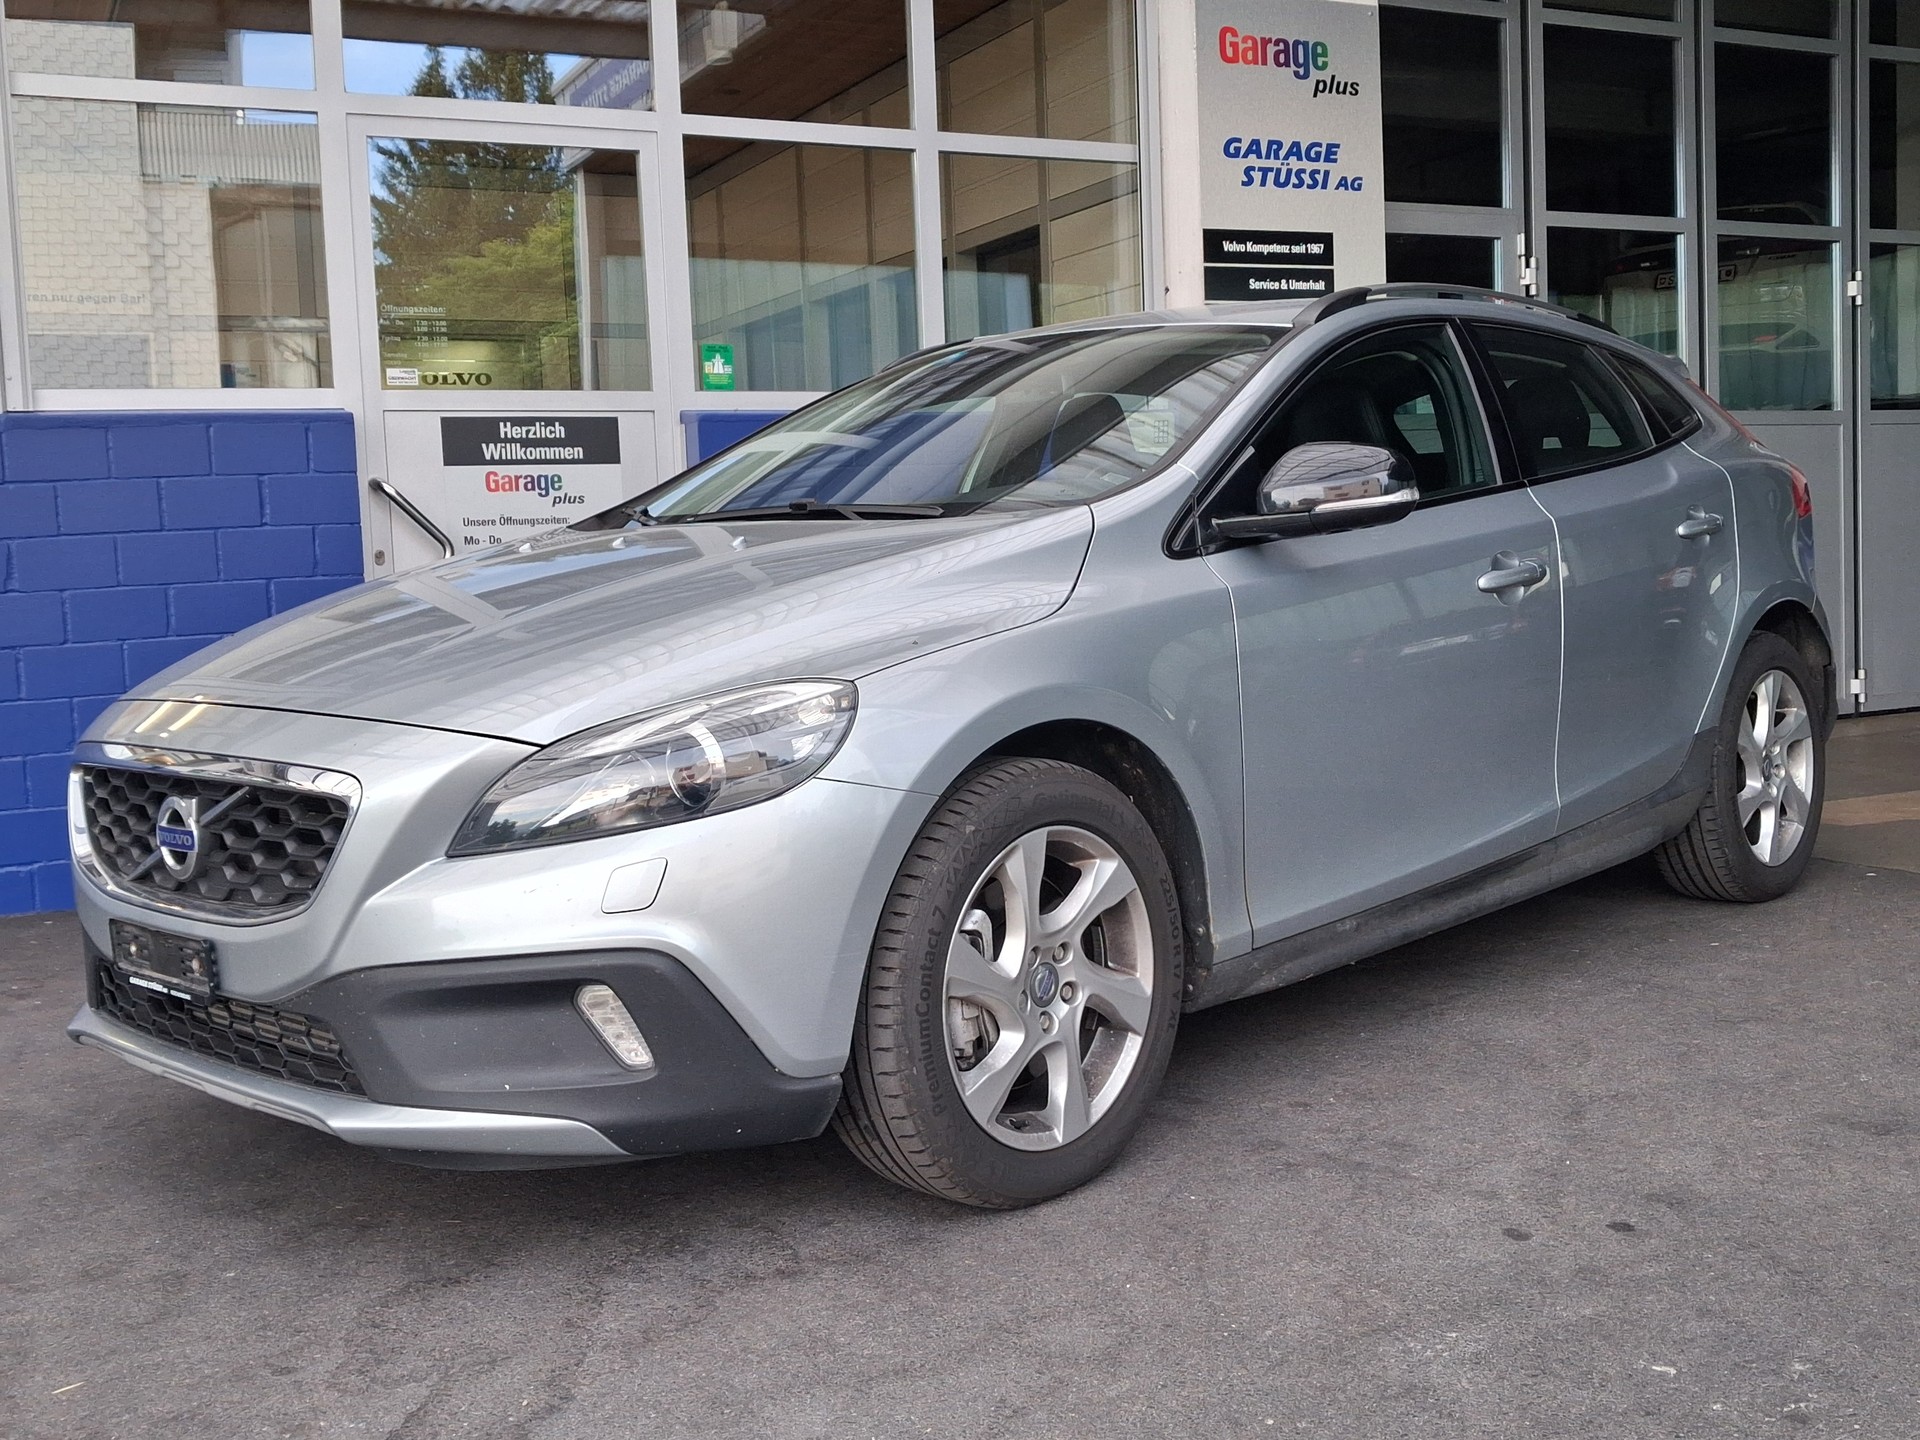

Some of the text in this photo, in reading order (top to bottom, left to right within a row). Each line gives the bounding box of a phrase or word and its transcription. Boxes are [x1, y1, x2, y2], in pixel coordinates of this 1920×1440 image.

[1219, 26, 1328, 80] Garage
[1313, 74, 1360, 98] plus
[1223, 137, 1341, 164] GARAGE
[1241, 161, 1363, 191] STÜSSI AG
[1222, 240, 1324, 255] Volvo Kompetenz seit 1967
[1249, 278, 1325, 291] Service & Unterhalt
[77, 294, 116, 305] gegen
[380, 303, 447, 314] Öffnungszeiten:
[421, 372, 493, 386] OLVO
[500, 422, 565, 439] Herzlich
[482, 443, 584, 460] Willkommen
[485, 471, 563, 497] Garage
[552, 493, 585, 507] plus
[463, 514, 571, 528] Unsere Öffnungszeiten:
[464, 536, 480, 545] Mo
[158, 830, 192, 846] VOLVO
[915, 905, 947, 1117] PremiumContact 7
